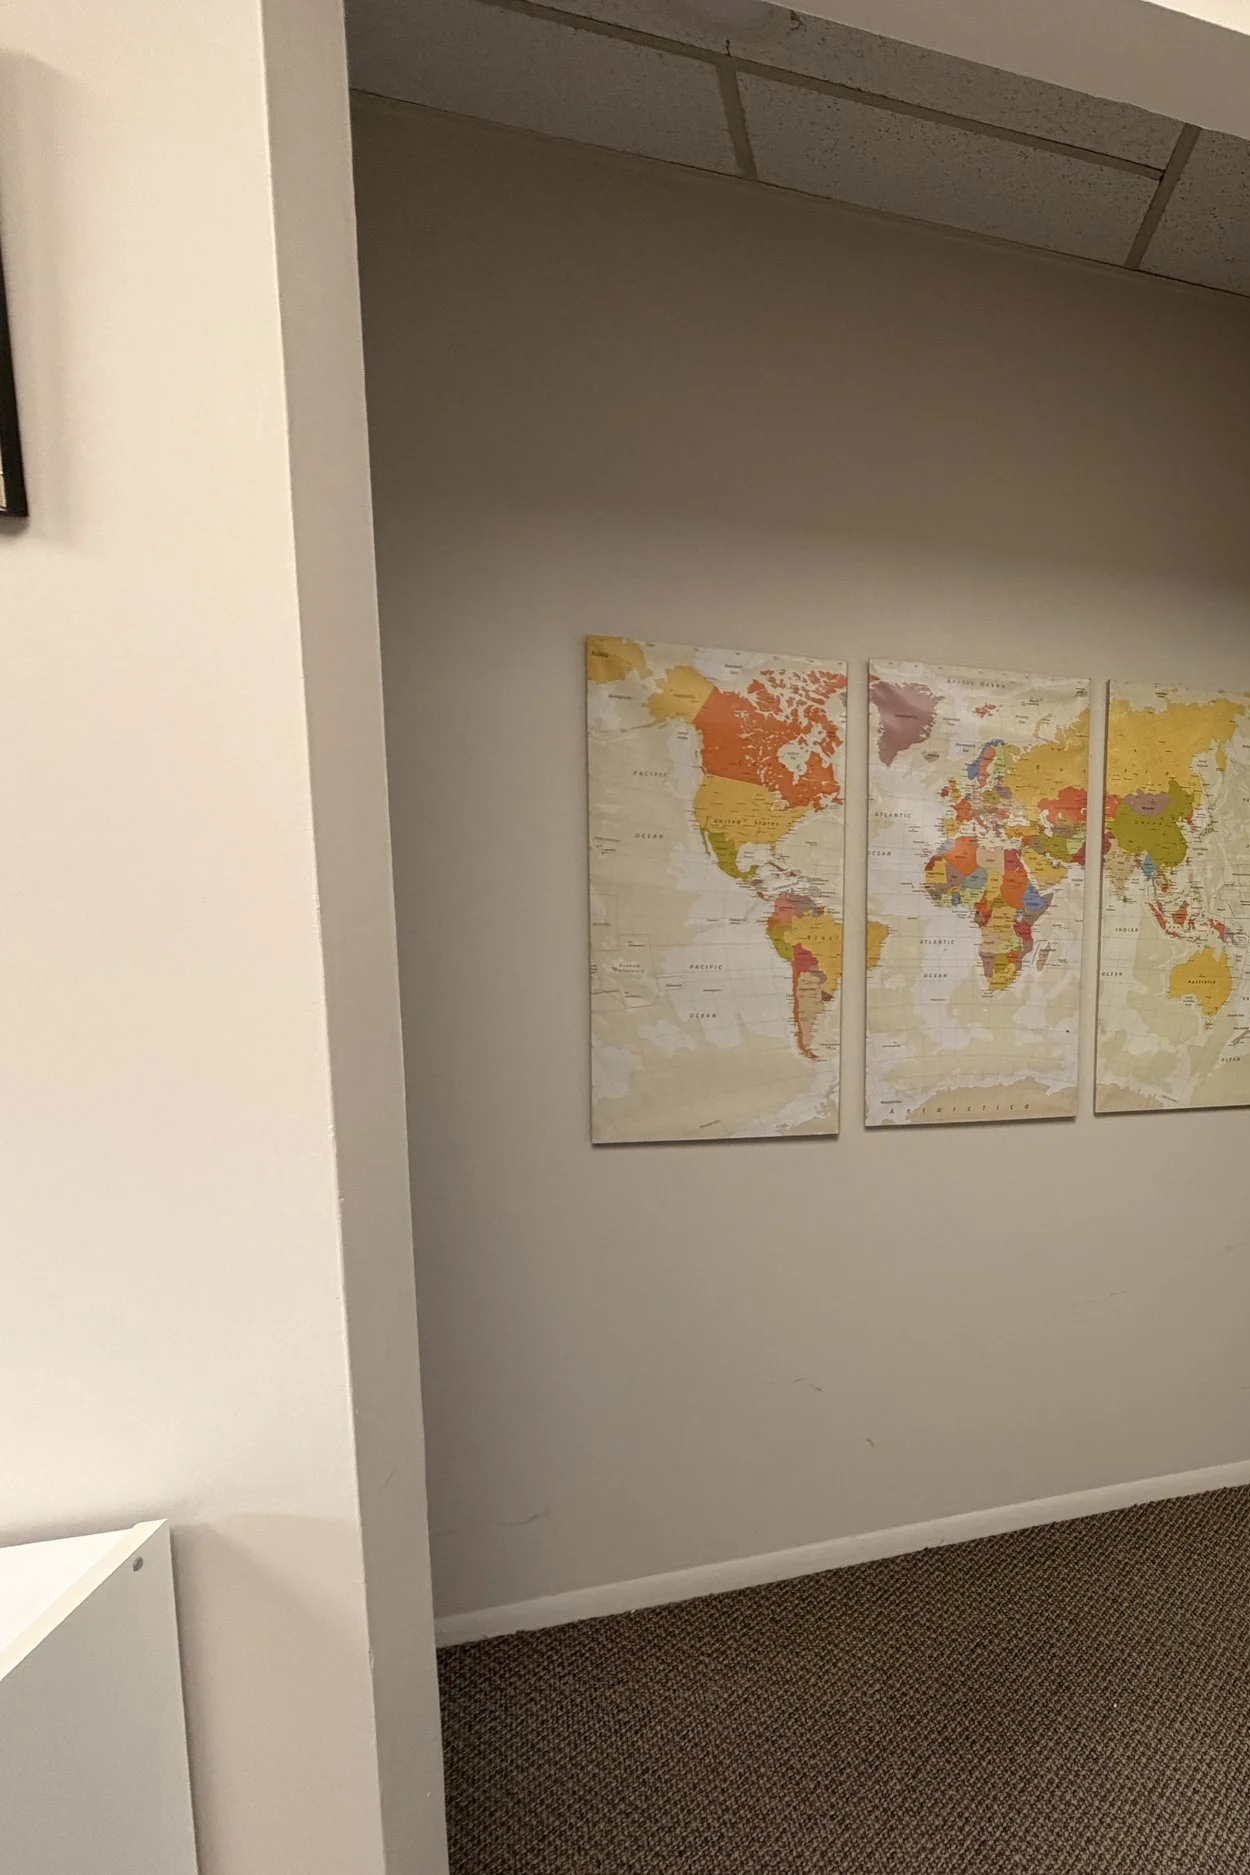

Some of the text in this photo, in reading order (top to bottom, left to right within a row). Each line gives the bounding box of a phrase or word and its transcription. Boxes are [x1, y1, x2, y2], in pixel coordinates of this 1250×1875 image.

[632, 770, 669, 778] PACIFIC
[875, 811, 912, 819] ATLANTIC
[633, 832, 665, 840] OCEAN
[888, 1103, 1031, 1115] Antarctica
